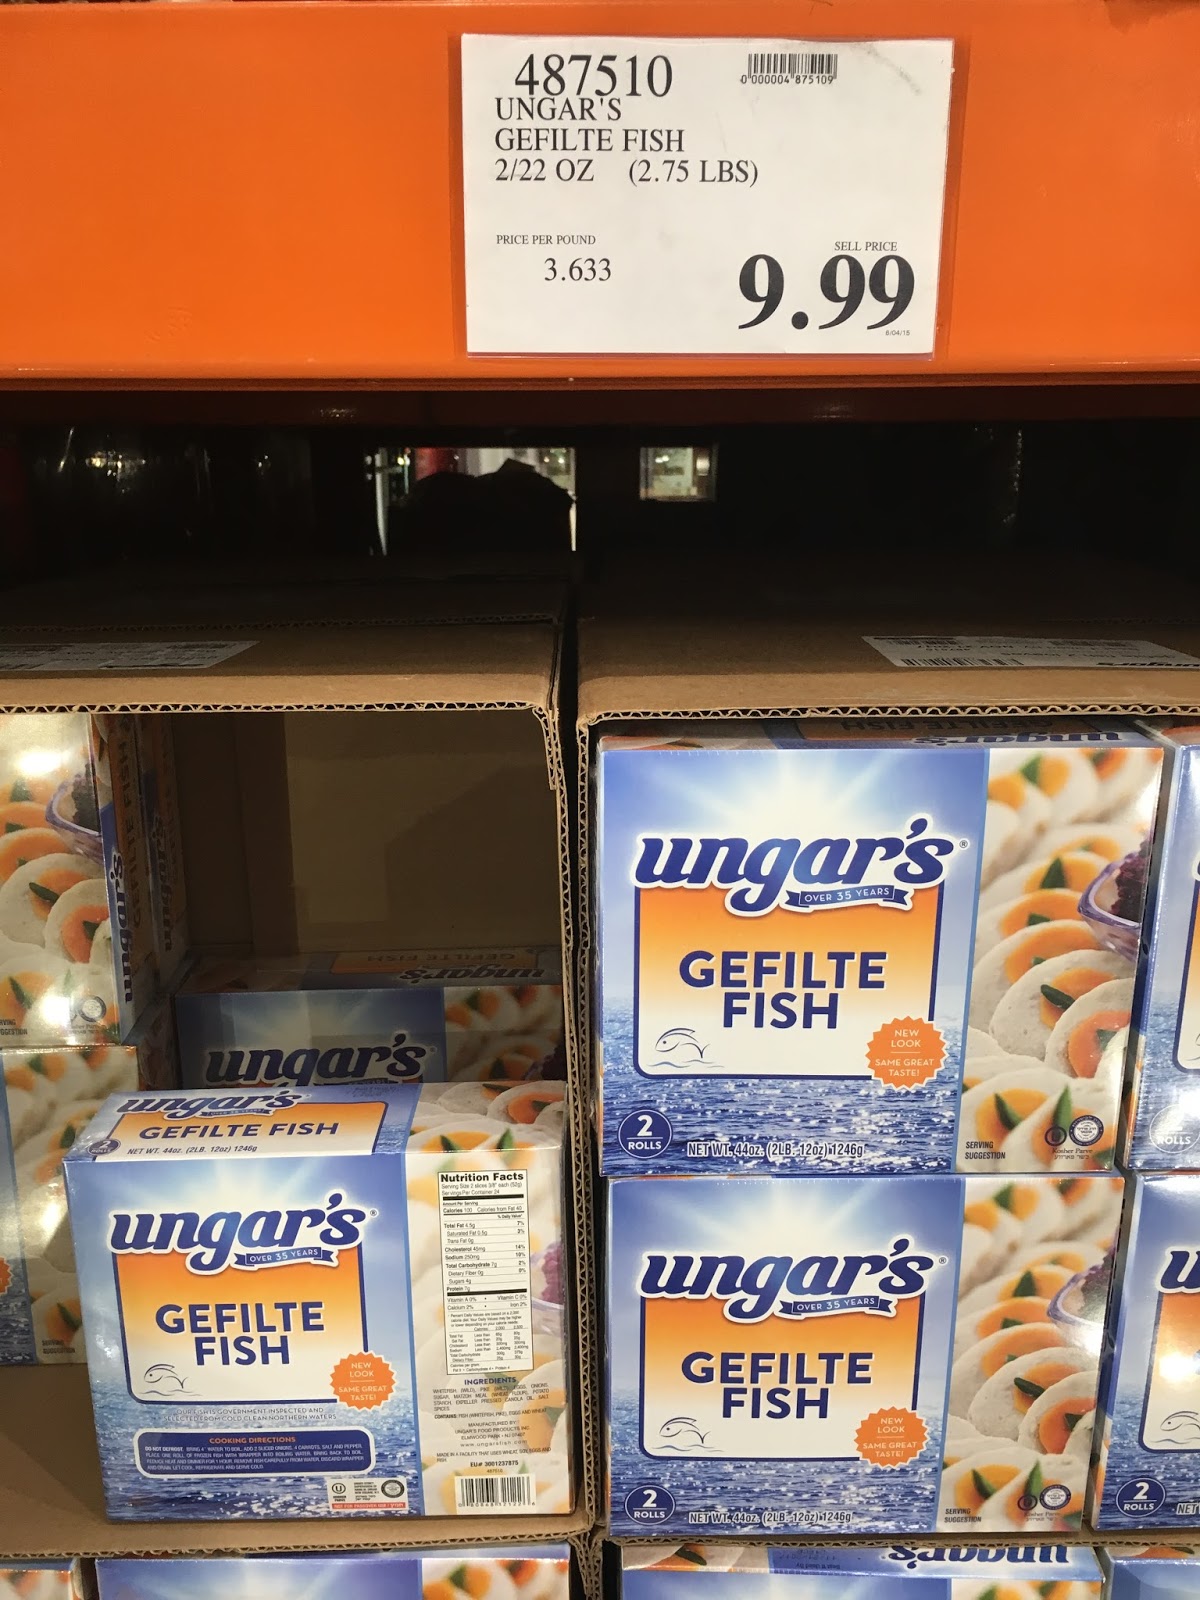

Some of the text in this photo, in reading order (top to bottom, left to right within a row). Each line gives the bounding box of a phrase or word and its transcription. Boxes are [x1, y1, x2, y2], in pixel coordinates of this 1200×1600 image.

[515, 54, 672, 97] 487510
[497, 98, 621, 120] UNGAR'S
[496, 128, 684, 152] GEFILTE FISH
[496, 159, 594, 182] 2/22 OZ
[629, 159, 758, 188] (2.75 LBS)
[496, 235, 596, 245] PRICE PER POUND
[834, 241, 898, 252] SELL PRICE
[544, 258, 611, 282] 3.633
[739, 255, 915, 330] 9.99
[913, 731, 1119, 746] ungar's
[635, 817, 954, 912] ungar's
[804, 887, 890, 903] OVER 35 YEARS
[679, 950, 887, 989] GEFILTE
[723, 992, 839, 1029] FISH
[894, 1029, 919, 1037] NEW
[891, 1040, 921, 1048] LOOK
[206, 1033, 427, 1087] ungar's
[875, 1059, 933, 1067] SAME GREAT
[117, 1090, 302, 1119] ungar's
[139, 1122, 339, 1140] GEFILTE FISH
[636, 1115, 653, 1137] 2
[233, 1145, 257, 1153] 1246g
[628, 1141, 662, 1150] ROLLS
[688, 1143, 710, 1157] NET
[831, 1142, 864, 1158] 1246g
[965, 1141, 994, 1149] SERVING
[965, 1151, 1006, 1160] SUGGESTION
[440, 1172, 524, 1182] Nutrition Facts
[110, 1192, 366, 1271] ungar's
[250, 1249, 319, 1263] OVER 35 YEARS
[641, 1238, 934, 1319] ungar's
[796, 1297, 875, 1311] OVER 35 YEARS
[155, 1301, 325, 1334] GEFILTE
[194, 1335, 290, 1366] FISH
[349, 1370, 374, 1378] LOOK
[681, 1351, 873, 1385] GEFILTE
[464, 1377, 517, 1385] INGREDIENTS
[722, 1387, 829, 1419] FISH
[880, 1417, 904, 1425] NEW
[878, 1426, 905, 1434] LOOK
[889, 1441, 917, 1449] GREAT
[642, 1489, 658, 1508] 2
[1133, 1481, 1150, 1500] 2
[634, 1511, 665, 1519] ROLLS
[1123, 1503, 1154, 1511] ROLLS
[1177, 1503, 1197, 1514] NET
[690, 1512, 710, 1524] NET
[821, 1510, 852, 1525] 1246g
